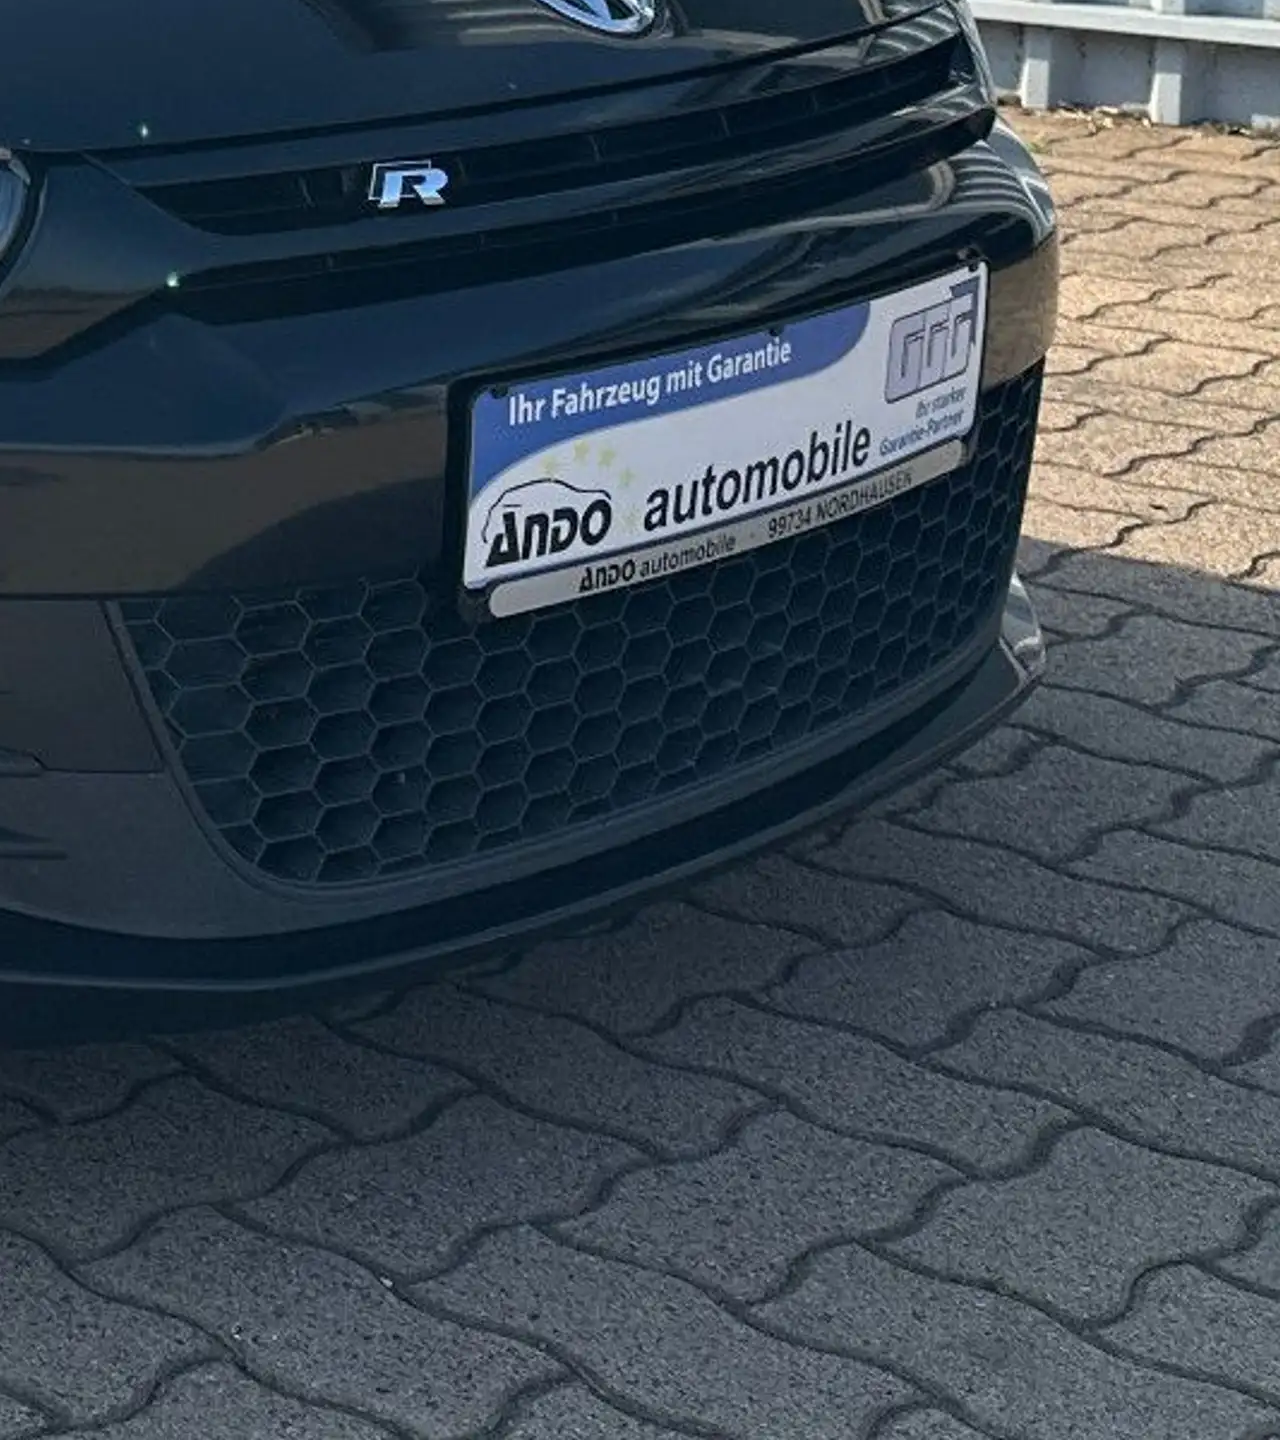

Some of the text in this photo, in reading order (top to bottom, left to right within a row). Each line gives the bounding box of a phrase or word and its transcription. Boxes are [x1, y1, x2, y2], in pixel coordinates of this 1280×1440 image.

[509, 336, 792, 426] Ihr Fahrzeug mit Garantie
[640, 532, 737, 579] automobile
[767, 508, 813, 539] 99734
[816, 469, 913, 521] NORDHAUSEN
[643, 420, 871, 532] automobile
